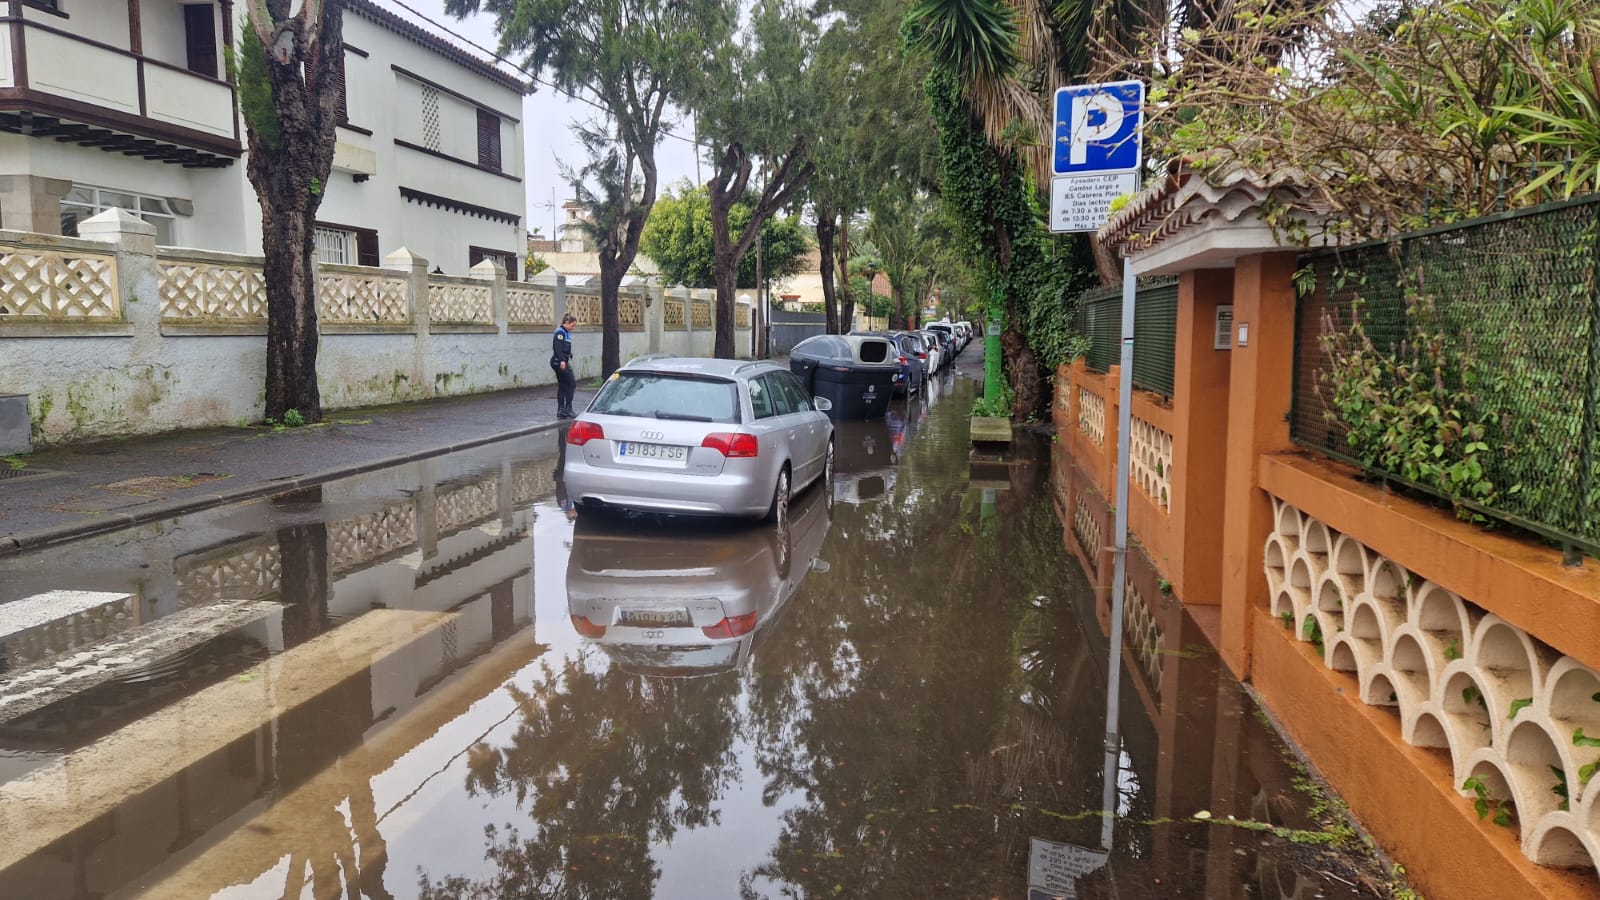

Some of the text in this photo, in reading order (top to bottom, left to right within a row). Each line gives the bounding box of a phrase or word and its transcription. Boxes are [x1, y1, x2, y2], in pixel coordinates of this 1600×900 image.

[1070, 94, 1124, 165] P
[628, 443, 683, 459] 9183 FSG
